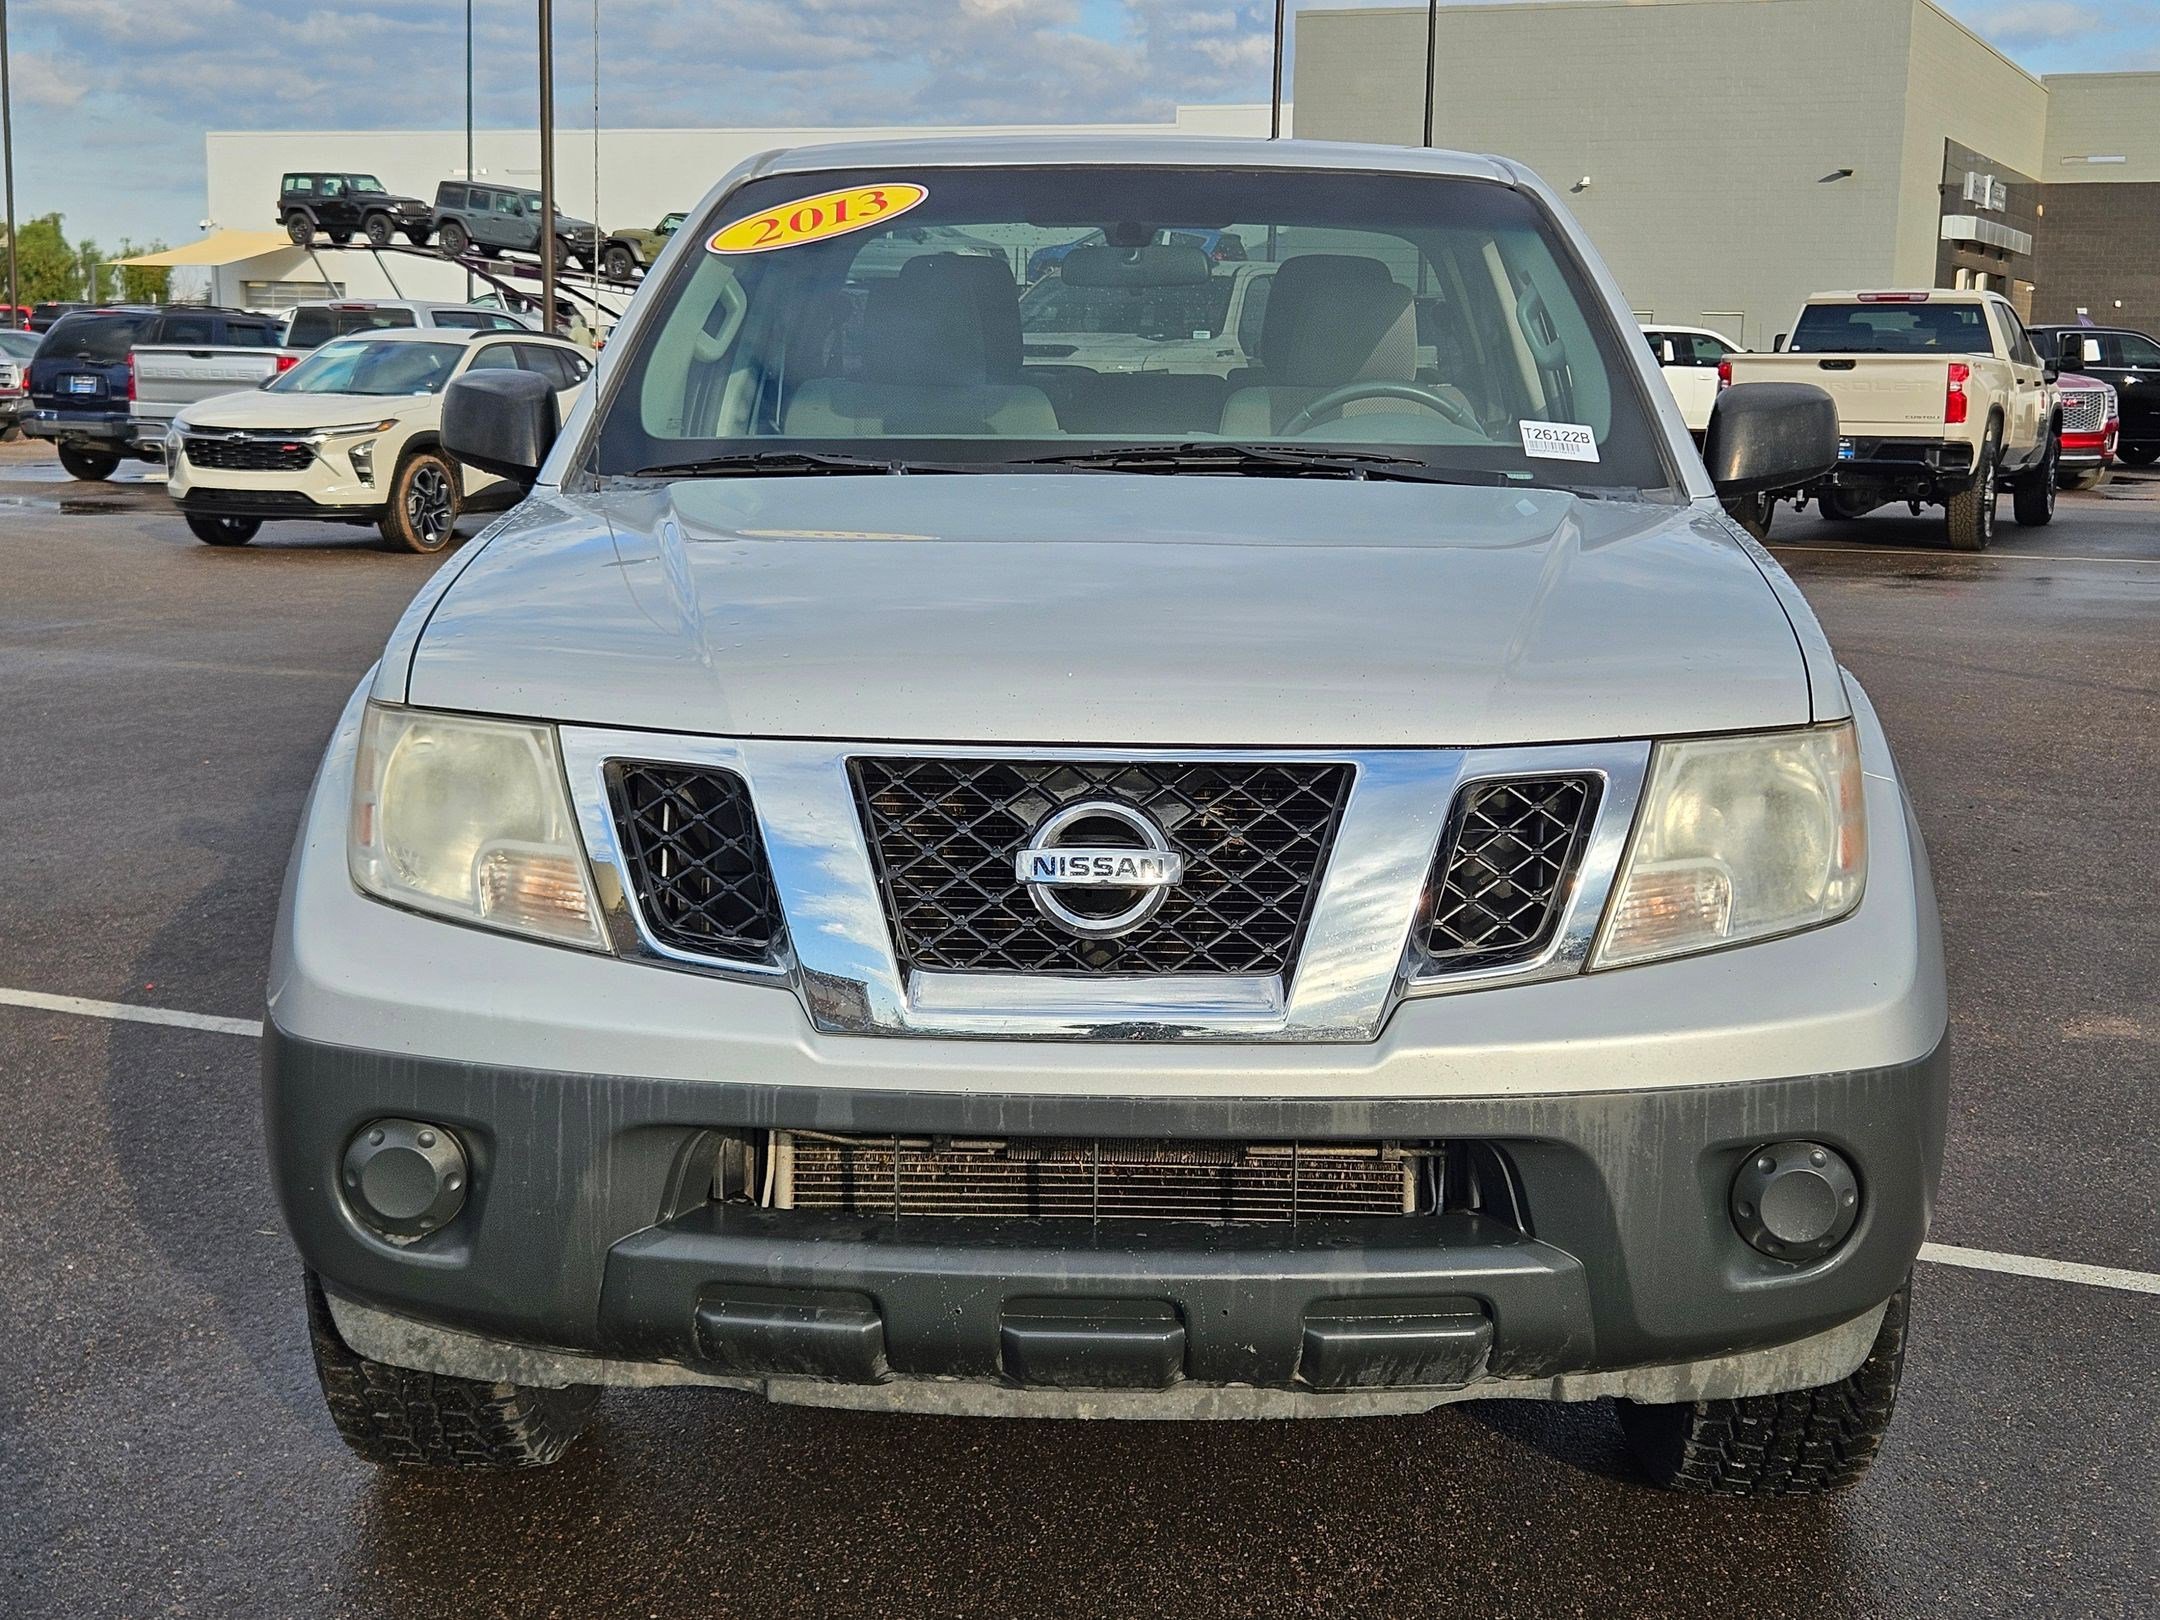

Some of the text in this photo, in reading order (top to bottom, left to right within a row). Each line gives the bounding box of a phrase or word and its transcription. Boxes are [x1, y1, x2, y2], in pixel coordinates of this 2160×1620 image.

[750, 191, 889, 246] 2013
[141, 367, 265, 380] CHEVROLET
[1827, 380, 1932, 393] ROLET
[1523, 427, 1591, 444] T26122B
[1033, 856, 1164, 879] NISSAN
